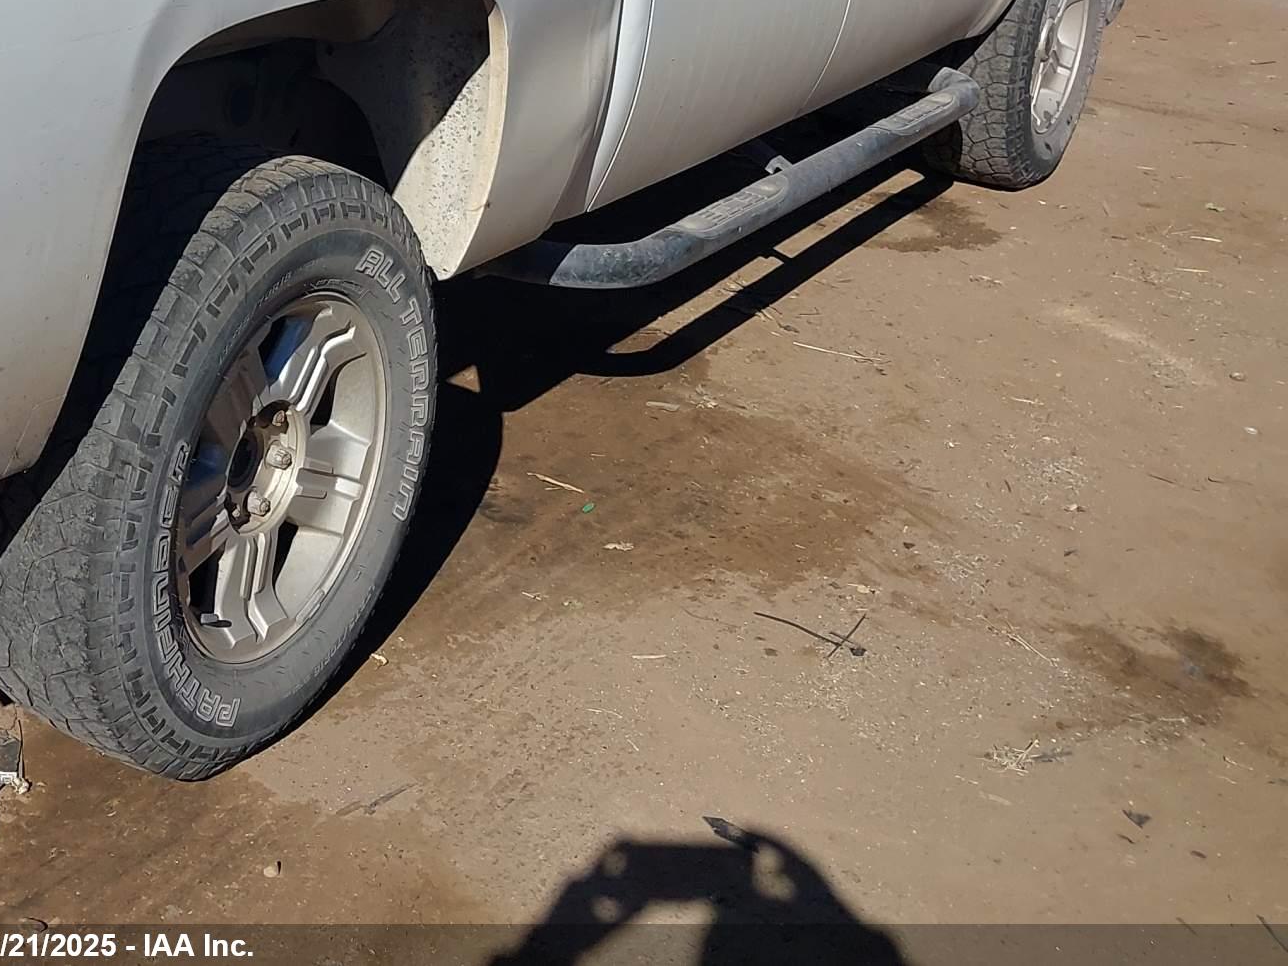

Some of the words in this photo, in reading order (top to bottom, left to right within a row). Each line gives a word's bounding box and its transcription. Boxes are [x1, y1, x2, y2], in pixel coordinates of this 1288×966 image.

[355, 248, 406, 304] ALL
[391, 297, 430, 522] TERRAIN
[152, 439, 241, 728] PATHFINDER
